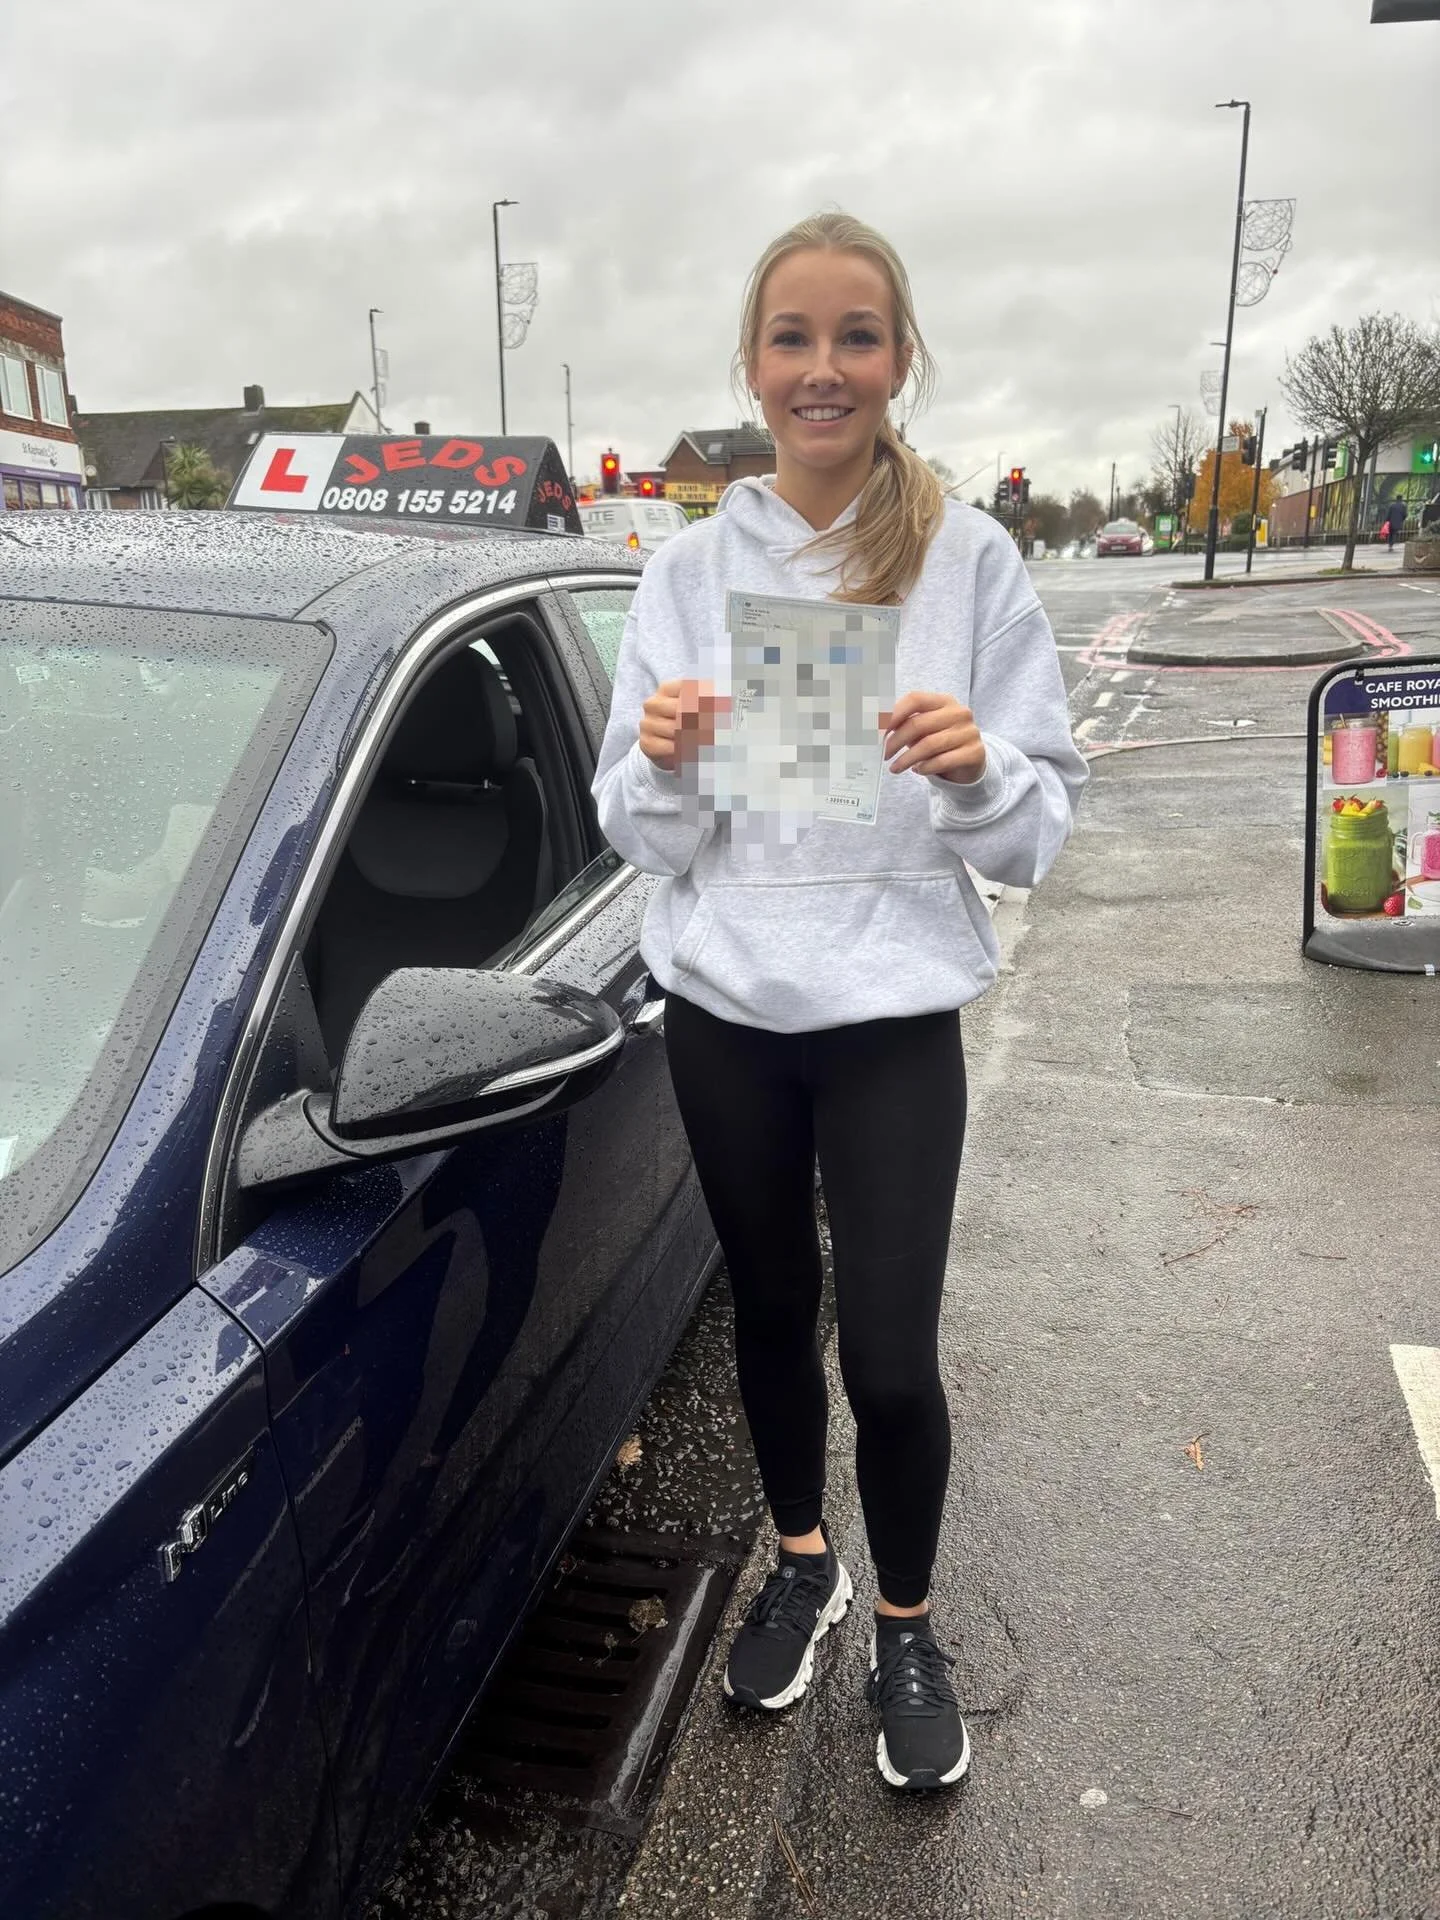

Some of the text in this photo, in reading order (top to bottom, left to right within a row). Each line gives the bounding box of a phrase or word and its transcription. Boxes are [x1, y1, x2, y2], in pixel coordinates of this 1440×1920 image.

[260, 448, 309, 493] L
[344, 438, 528, 487] JEDS
[322, 486, 517, 514] 0808 155 5214
[537, 480, 572, 512] JEDS
[1365, 681, 1402, 694] CAFE
[1370, 694, 1440, 709] SMOOTHI
